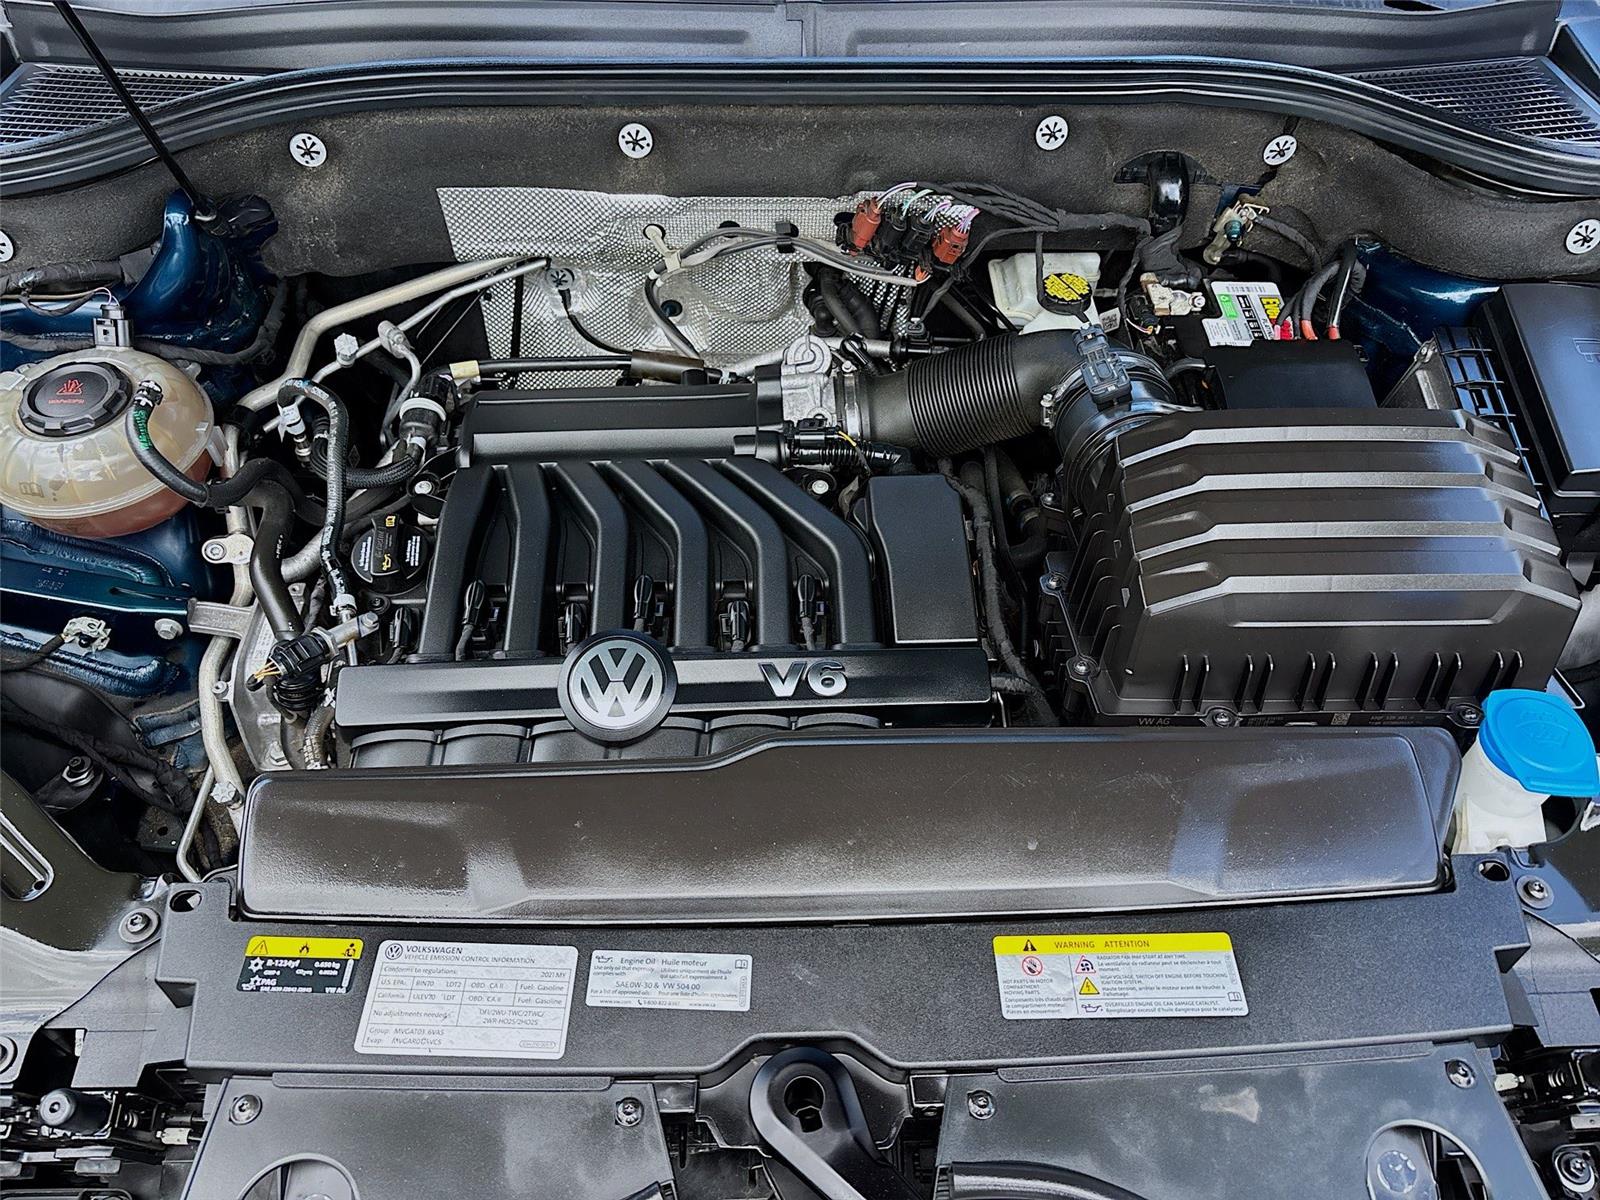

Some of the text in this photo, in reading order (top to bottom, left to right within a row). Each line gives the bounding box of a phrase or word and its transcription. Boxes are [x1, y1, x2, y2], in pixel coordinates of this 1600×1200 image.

[758, 659, 848, 698] V6
[1138, 717, 1171, 726] VW AG
[406, 944, 464, 954] VOLKSWAGEN
[1054, 940, 1095, 949] WARNING
[492, 956, 536, 964] INFORMATION
[620, 958, 644, 966] Engine
